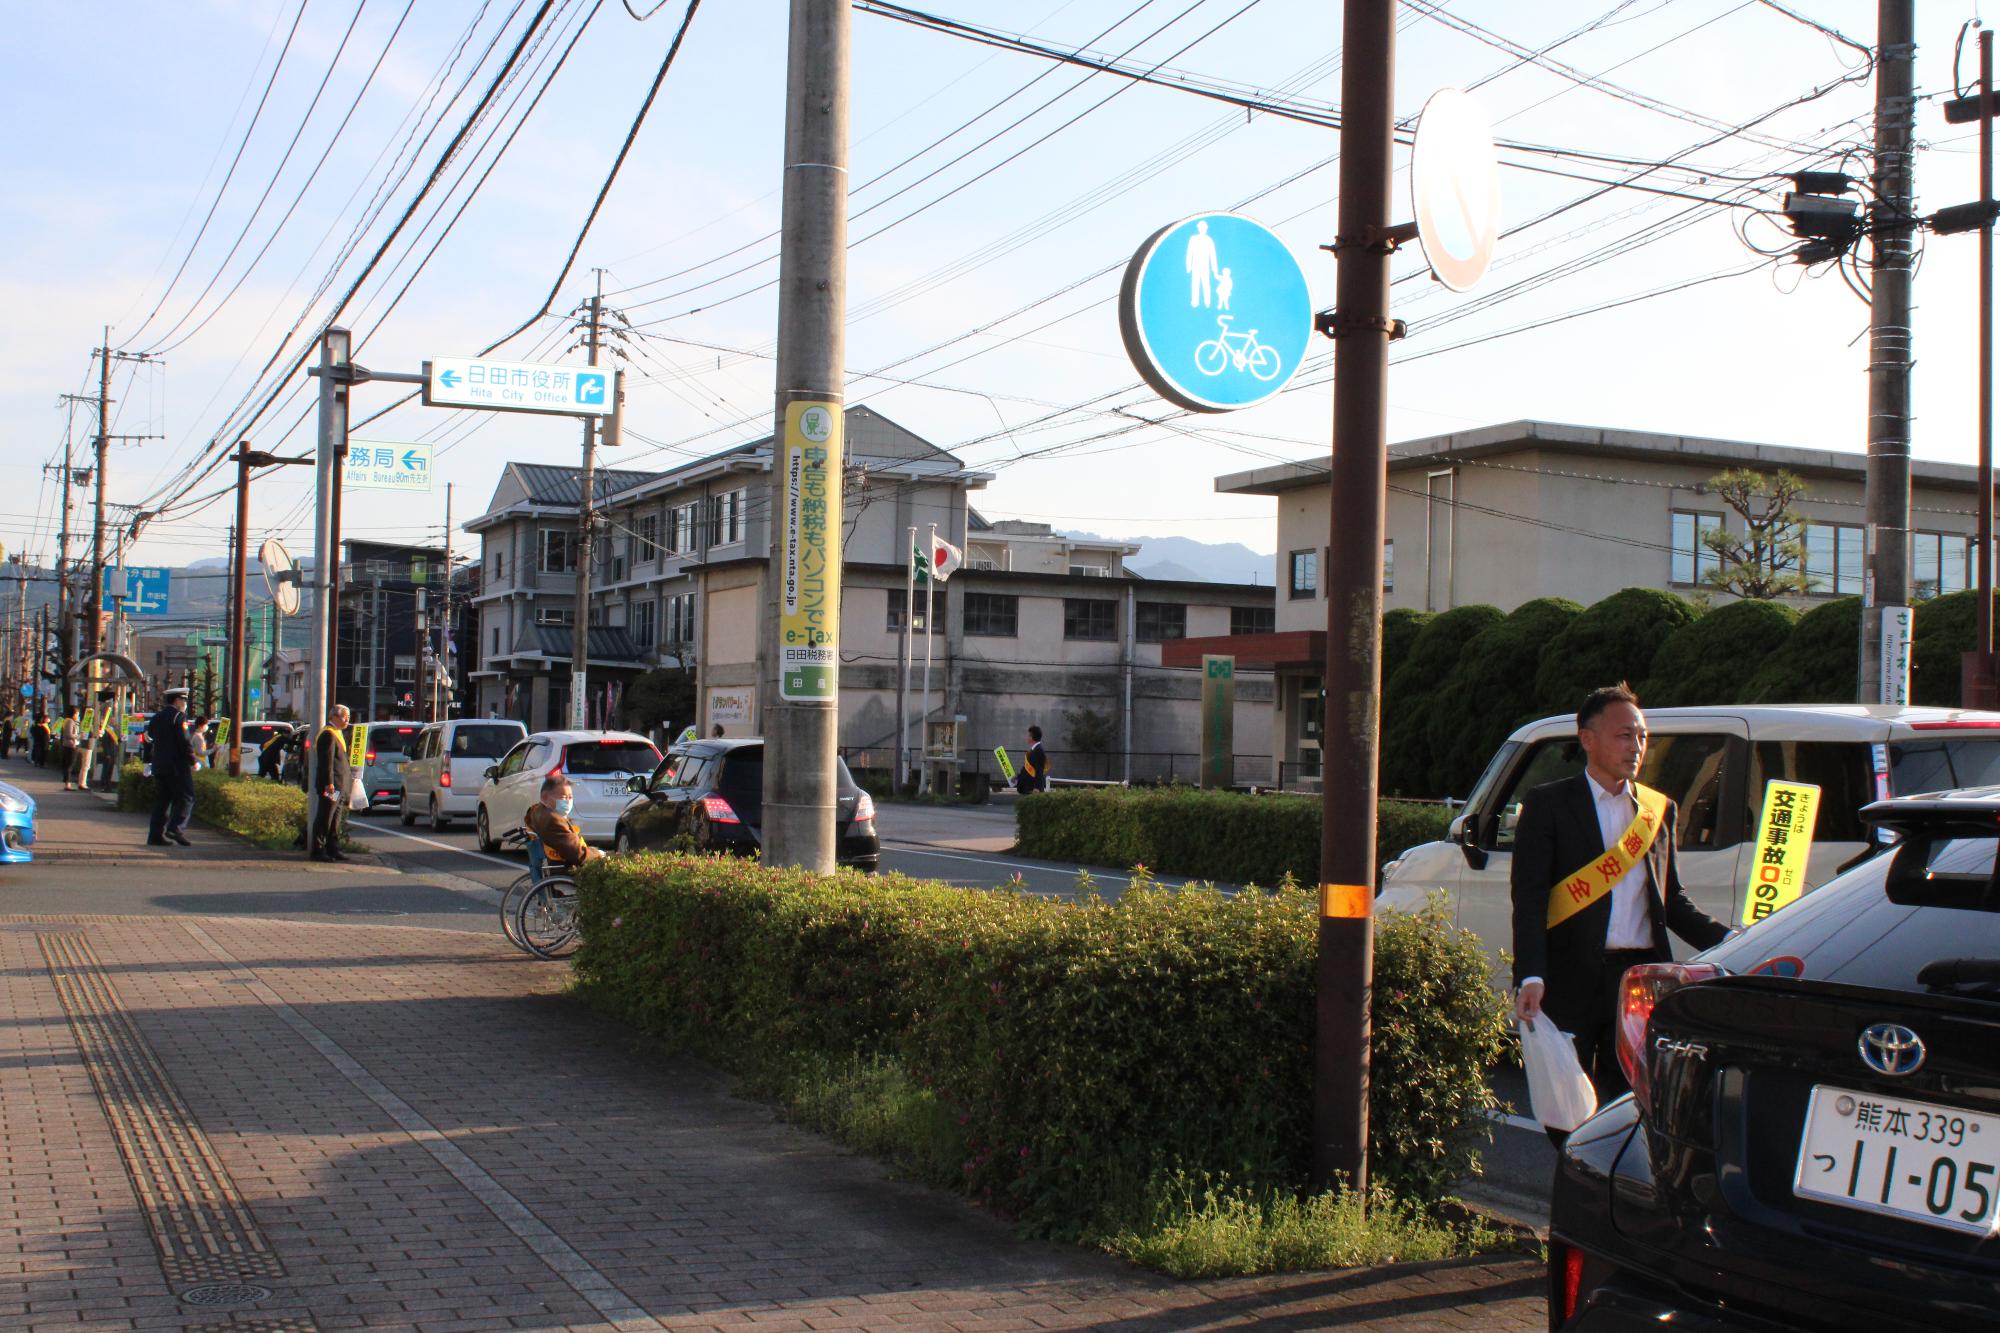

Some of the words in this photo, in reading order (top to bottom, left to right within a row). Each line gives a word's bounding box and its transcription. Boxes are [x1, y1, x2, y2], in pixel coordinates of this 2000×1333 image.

[468, 365, 572, 391] 日田市役所
[470, 386, 493, 398] Hita
[502, 388, 525, 402] City
[534, 391, 568, 404] Office
[343, 447, 395, 469] 務局
[802, 447, 828, 624] 申告も納税もパソコンで
[785, 626, 833, 645] e-Tax
[786, 649, 833, 662] 日田税務署
[1566, 806, 1658, 903] 交通安全
[1783, 868, 1794, 885] ゼロ
[1655, 1037, 1708, 1061] C-HR
[1855, 1101, 1911, 1137] 熊本
[1913, 1111, 1966, 1147] 339
[1813, 1154, 1836, 1172] つ
[1848, 1139, 1996, 1223] 11-05
